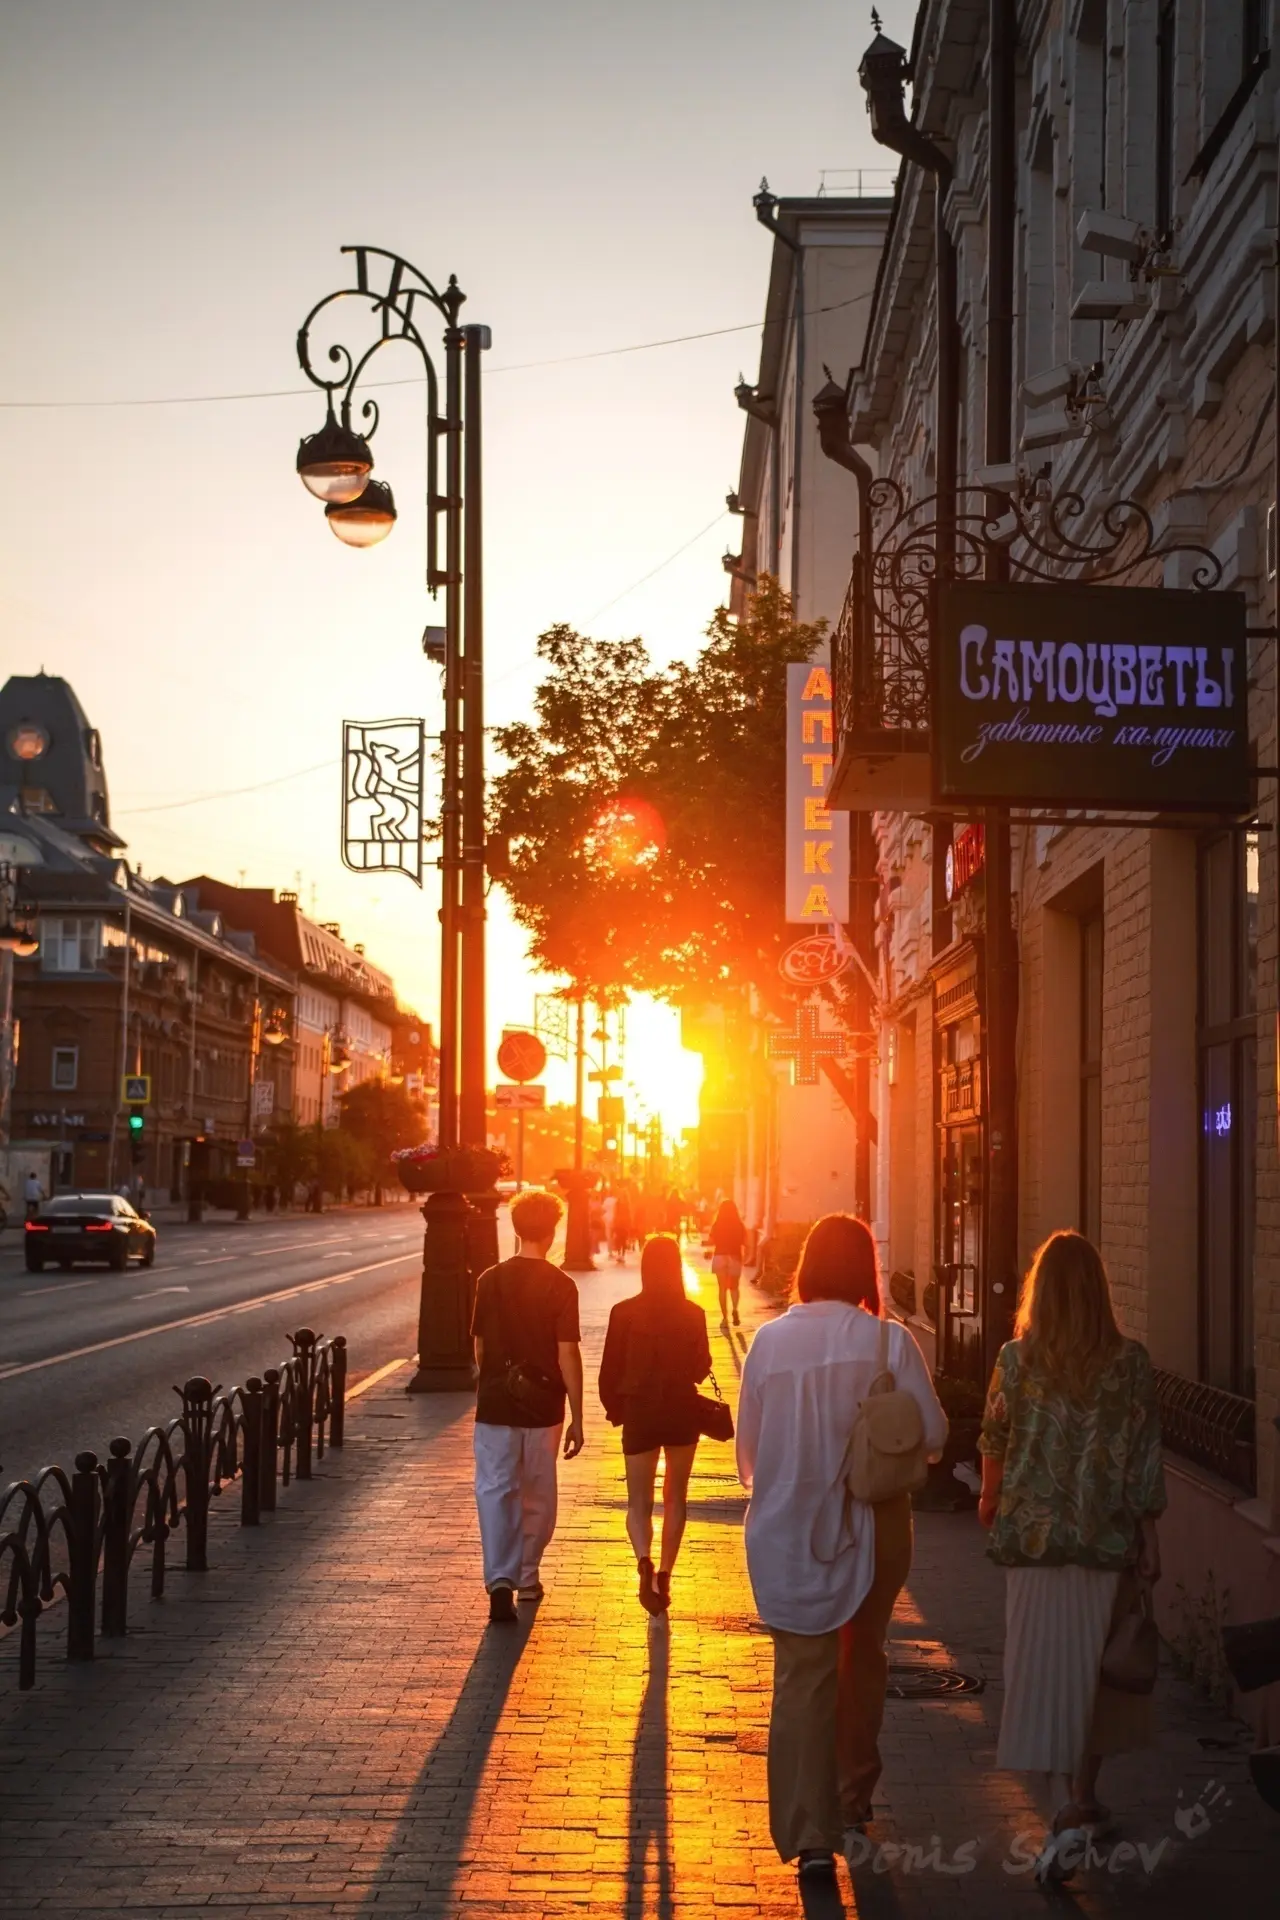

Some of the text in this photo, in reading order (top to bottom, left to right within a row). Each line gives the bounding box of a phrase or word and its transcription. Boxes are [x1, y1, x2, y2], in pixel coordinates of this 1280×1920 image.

[960, 624, 1234, 717] САМОЦВЕТЫ
[960, 706, 1236, 766] заветные камушки
[801, 667, 833, 917] АПТЕКА
